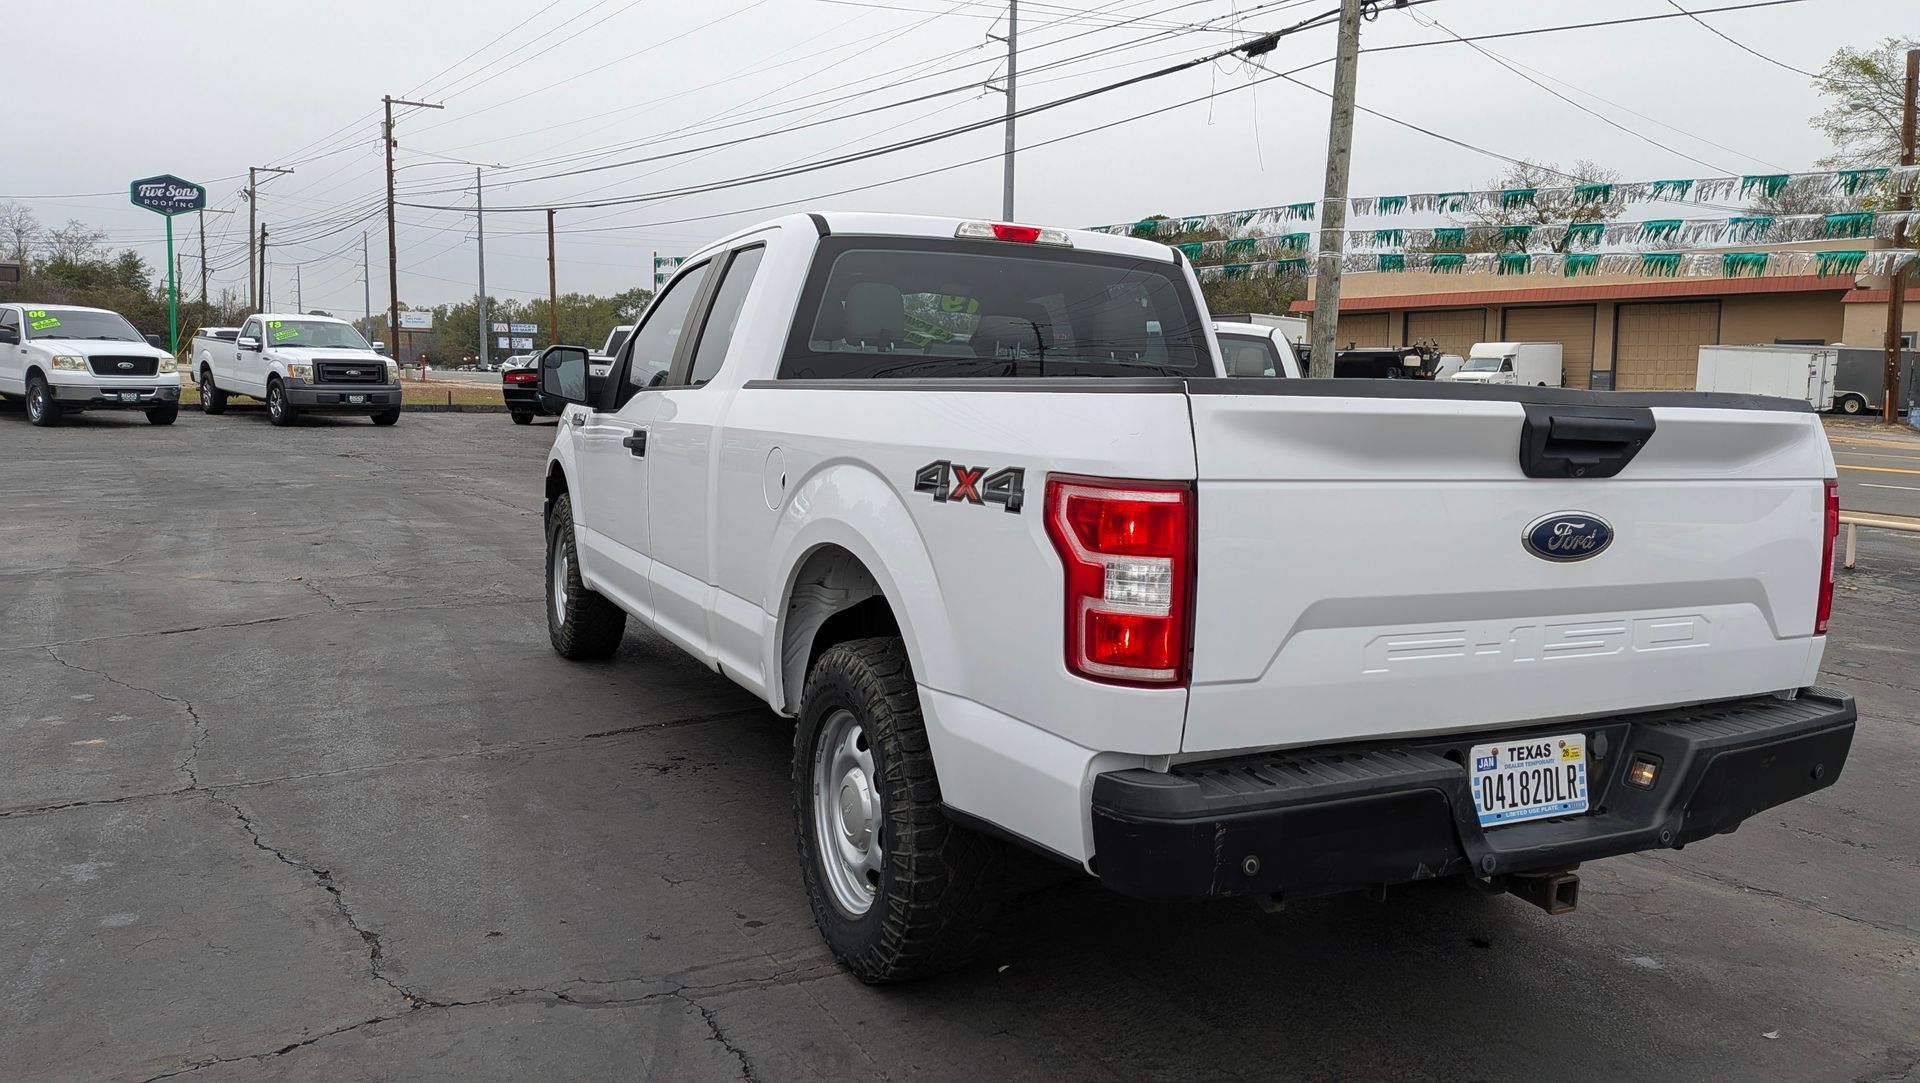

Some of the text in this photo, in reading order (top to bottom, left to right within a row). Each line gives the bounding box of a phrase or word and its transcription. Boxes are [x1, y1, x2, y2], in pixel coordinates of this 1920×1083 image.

[139, 183, 199, 201] Five Sons
[144, 199, 194, 208] ROOFING
[1548, 521, 1598, 550] Ford
[1362, 614, 1712, 674] F-150
[1508, 743, 1552, 762] TEXAS
[1562, 748, 1570, 758] 26
[1478, 757, 1495, 769] JAN
[1504, 759, 1555, 769] DEALER TEMPORARY
[1482, 764, 1578, 812] 04182DLR
[1505, 809, 1527, 817] LIMITED
